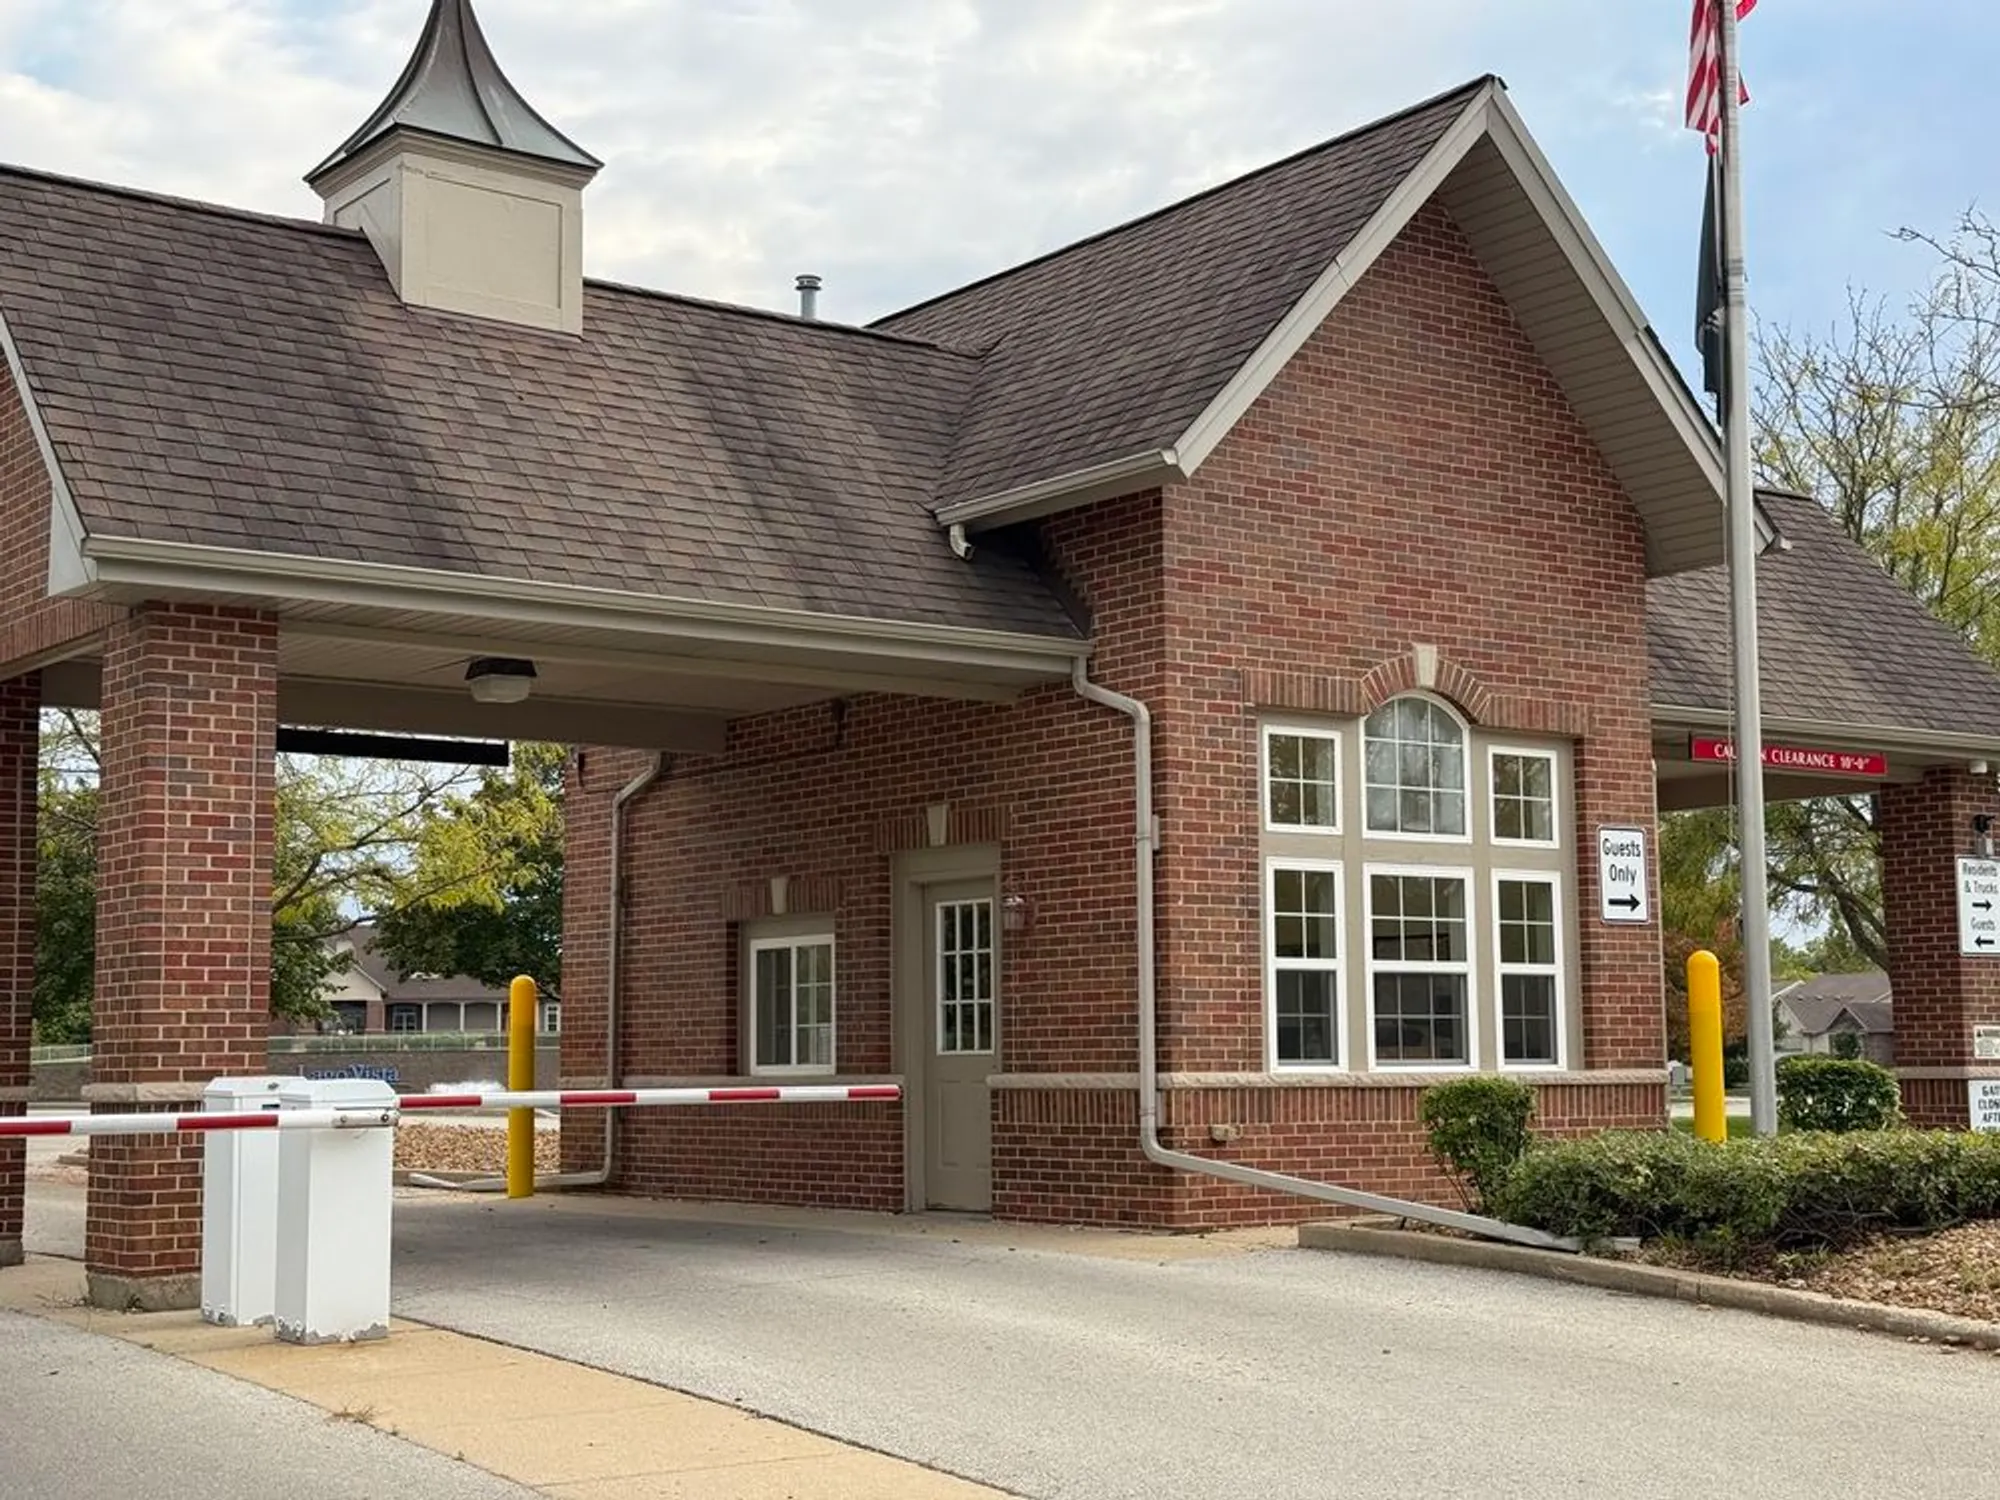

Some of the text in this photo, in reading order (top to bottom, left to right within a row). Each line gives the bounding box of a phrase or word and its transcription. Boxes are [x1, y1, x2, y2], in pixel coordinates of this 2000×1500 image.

[1713, 743, 1767, 761] CAUN
[1771, 749, 1835, 768] CLEARANCE
[1603, 838, 1641, 857] Guests
[1609, 864, 1637, 887] Only
[1982, 1085, 2000, 1097] GAT
